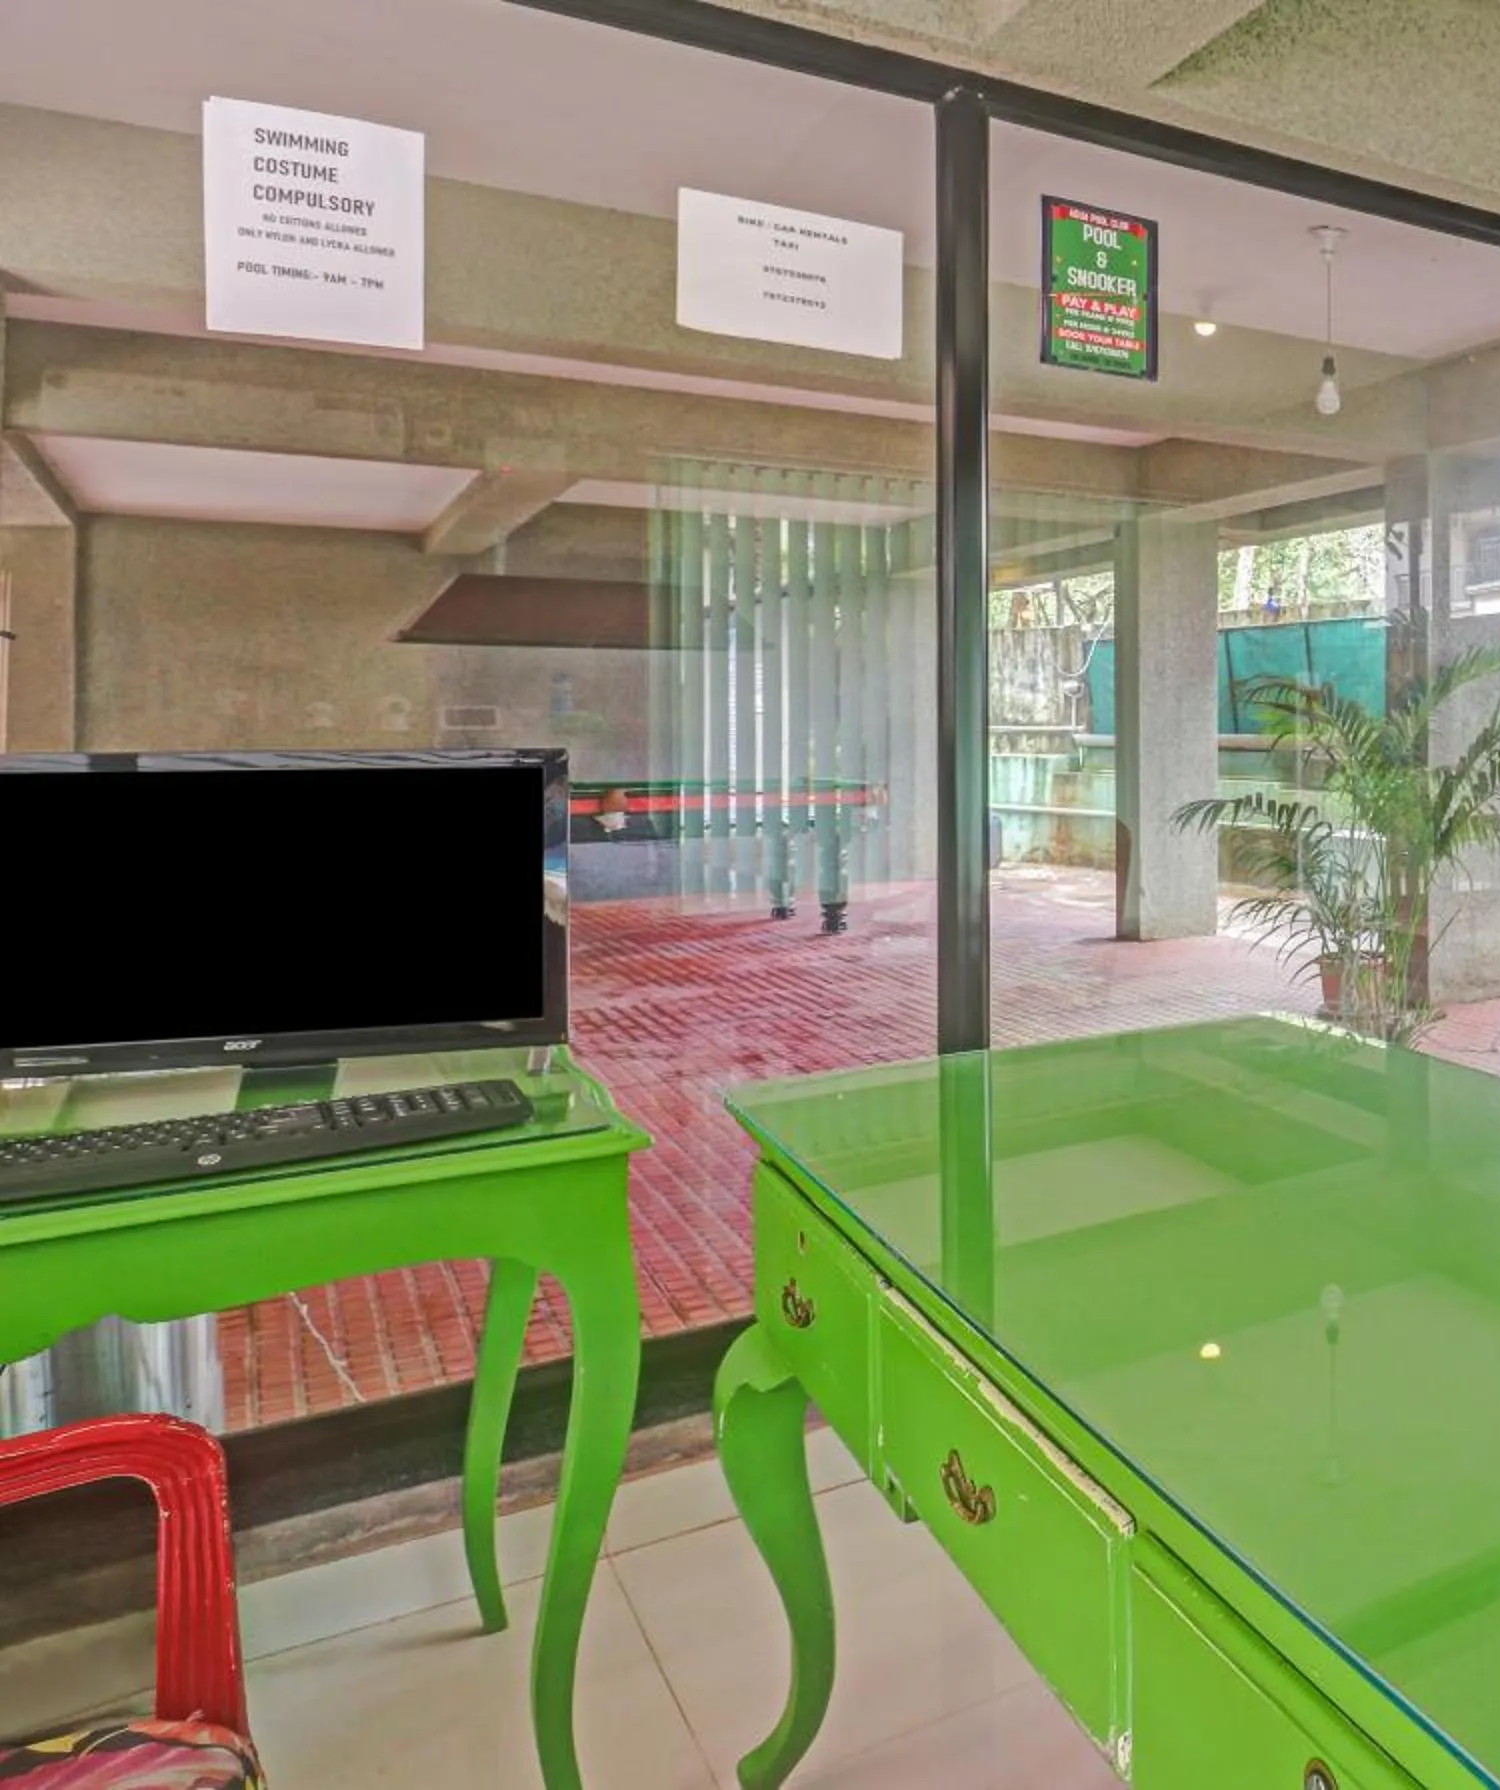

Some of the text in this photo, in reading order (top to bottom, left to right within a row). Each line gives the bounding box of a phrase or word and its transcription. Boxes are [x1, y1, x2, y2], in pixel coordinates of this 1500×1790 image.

[254, 127, 349, 157] SWIMMING
[253, 156, 338, 183] COSTUME
[252, 184, 376, 216] COMPULSORY
[238, 226, 262, 239] ONLY
[300, 236, 318, 247] AND
[321, 239, 350, 251] LYCRA
[774, 223, 796, 233] CAR
[799, 228, 848, 245] RENTALS
[1083, 223, 1121, 251] POOL
[1096, 251, 1107, 268] &
[237, 261, 267, 275] POOL
[323, 272, 347, 285] 9AM
[361, 277, 384, 289] 7PM
[1067, 267, 1136, 297] SNOOKER
[1061, 295, 1087, 310] PAY
[1104, 303, 1136, 320] PLAY
[223, 1039, 263, 1051] acer
